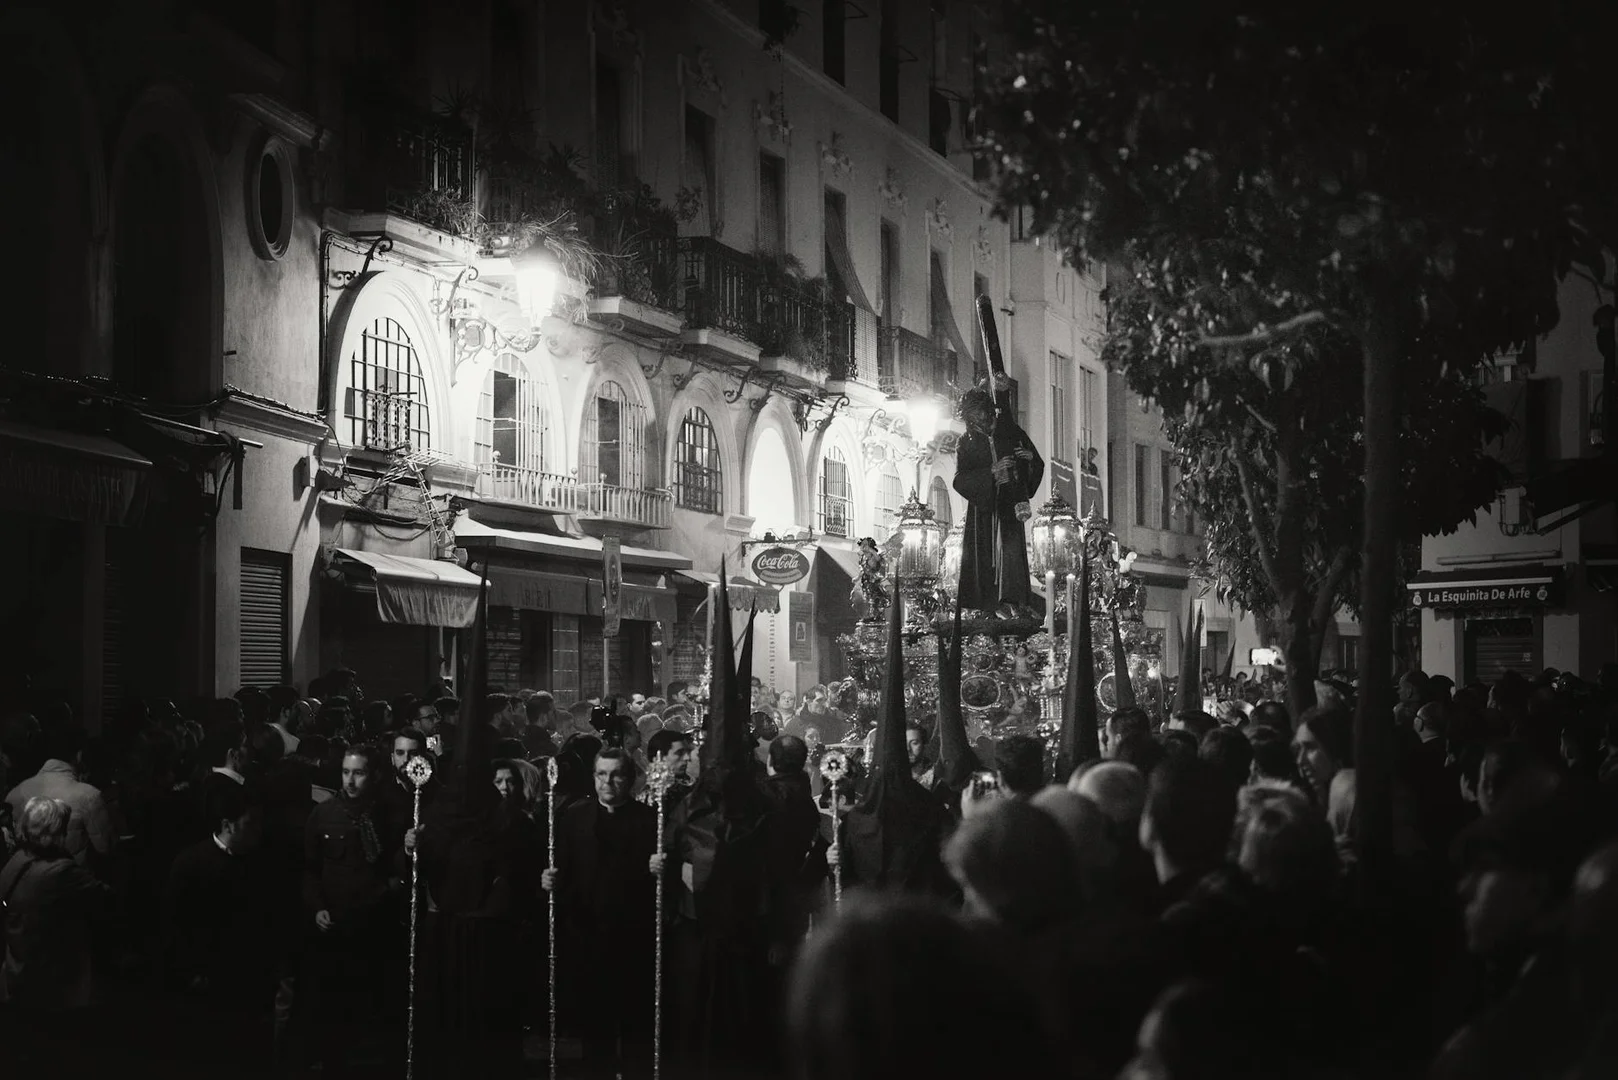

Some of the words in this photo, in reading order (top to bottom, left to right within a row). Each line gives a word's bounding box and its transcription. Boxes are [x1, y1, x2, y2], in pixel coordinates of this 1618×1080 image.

[1428, 591, 1440, 603] La
[1442, 588, 1489, 604] Esquinita
[1491, 588, 1505, 600] De
